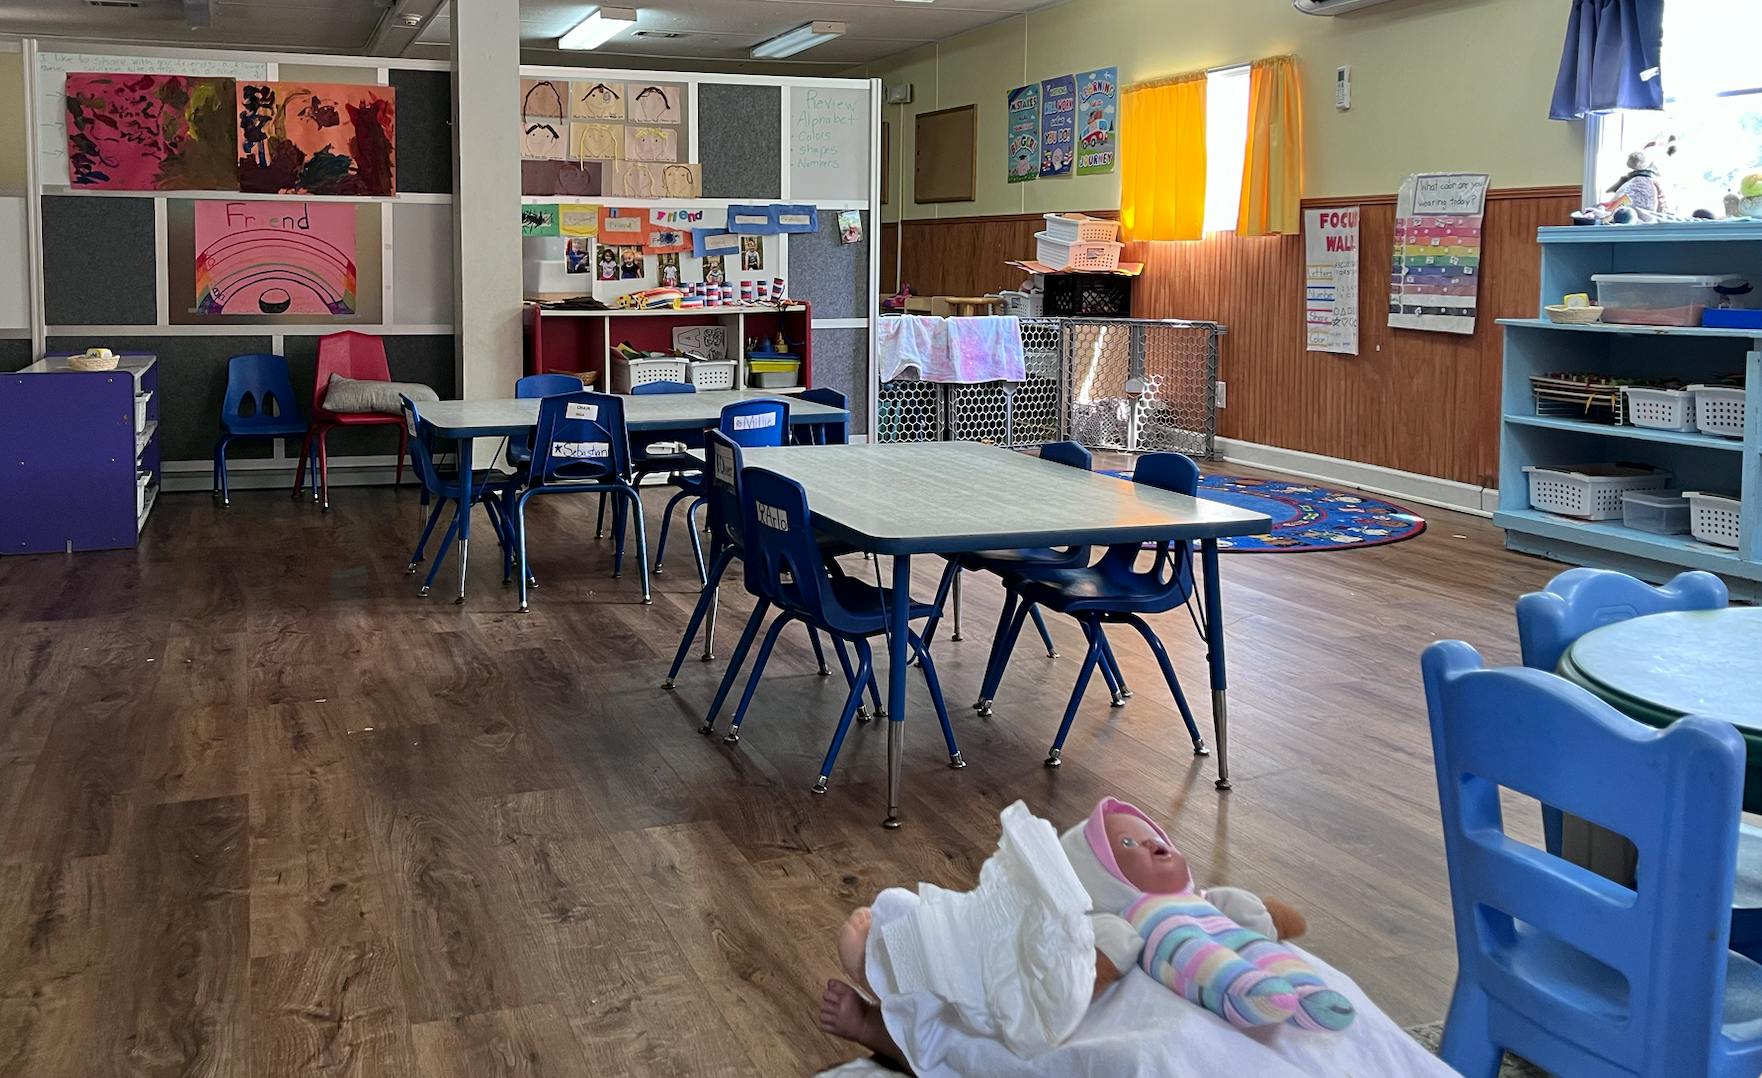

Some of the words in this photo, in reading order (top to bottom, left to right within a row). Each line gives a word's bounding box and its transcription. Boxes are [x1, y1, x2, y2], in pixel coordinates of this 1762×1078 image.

[1081, 81, 1114, 102] LEARNING
[806, 89, 857, 113] Review
[1080, 152, 1113, 168] JOURNEY
[1421, 180, 1438, 192] What
[1418, 200, 1447, 211] wearing
[563, 443, 608, 457] Sebastian
[766, 505, 787, 531] Arlo
